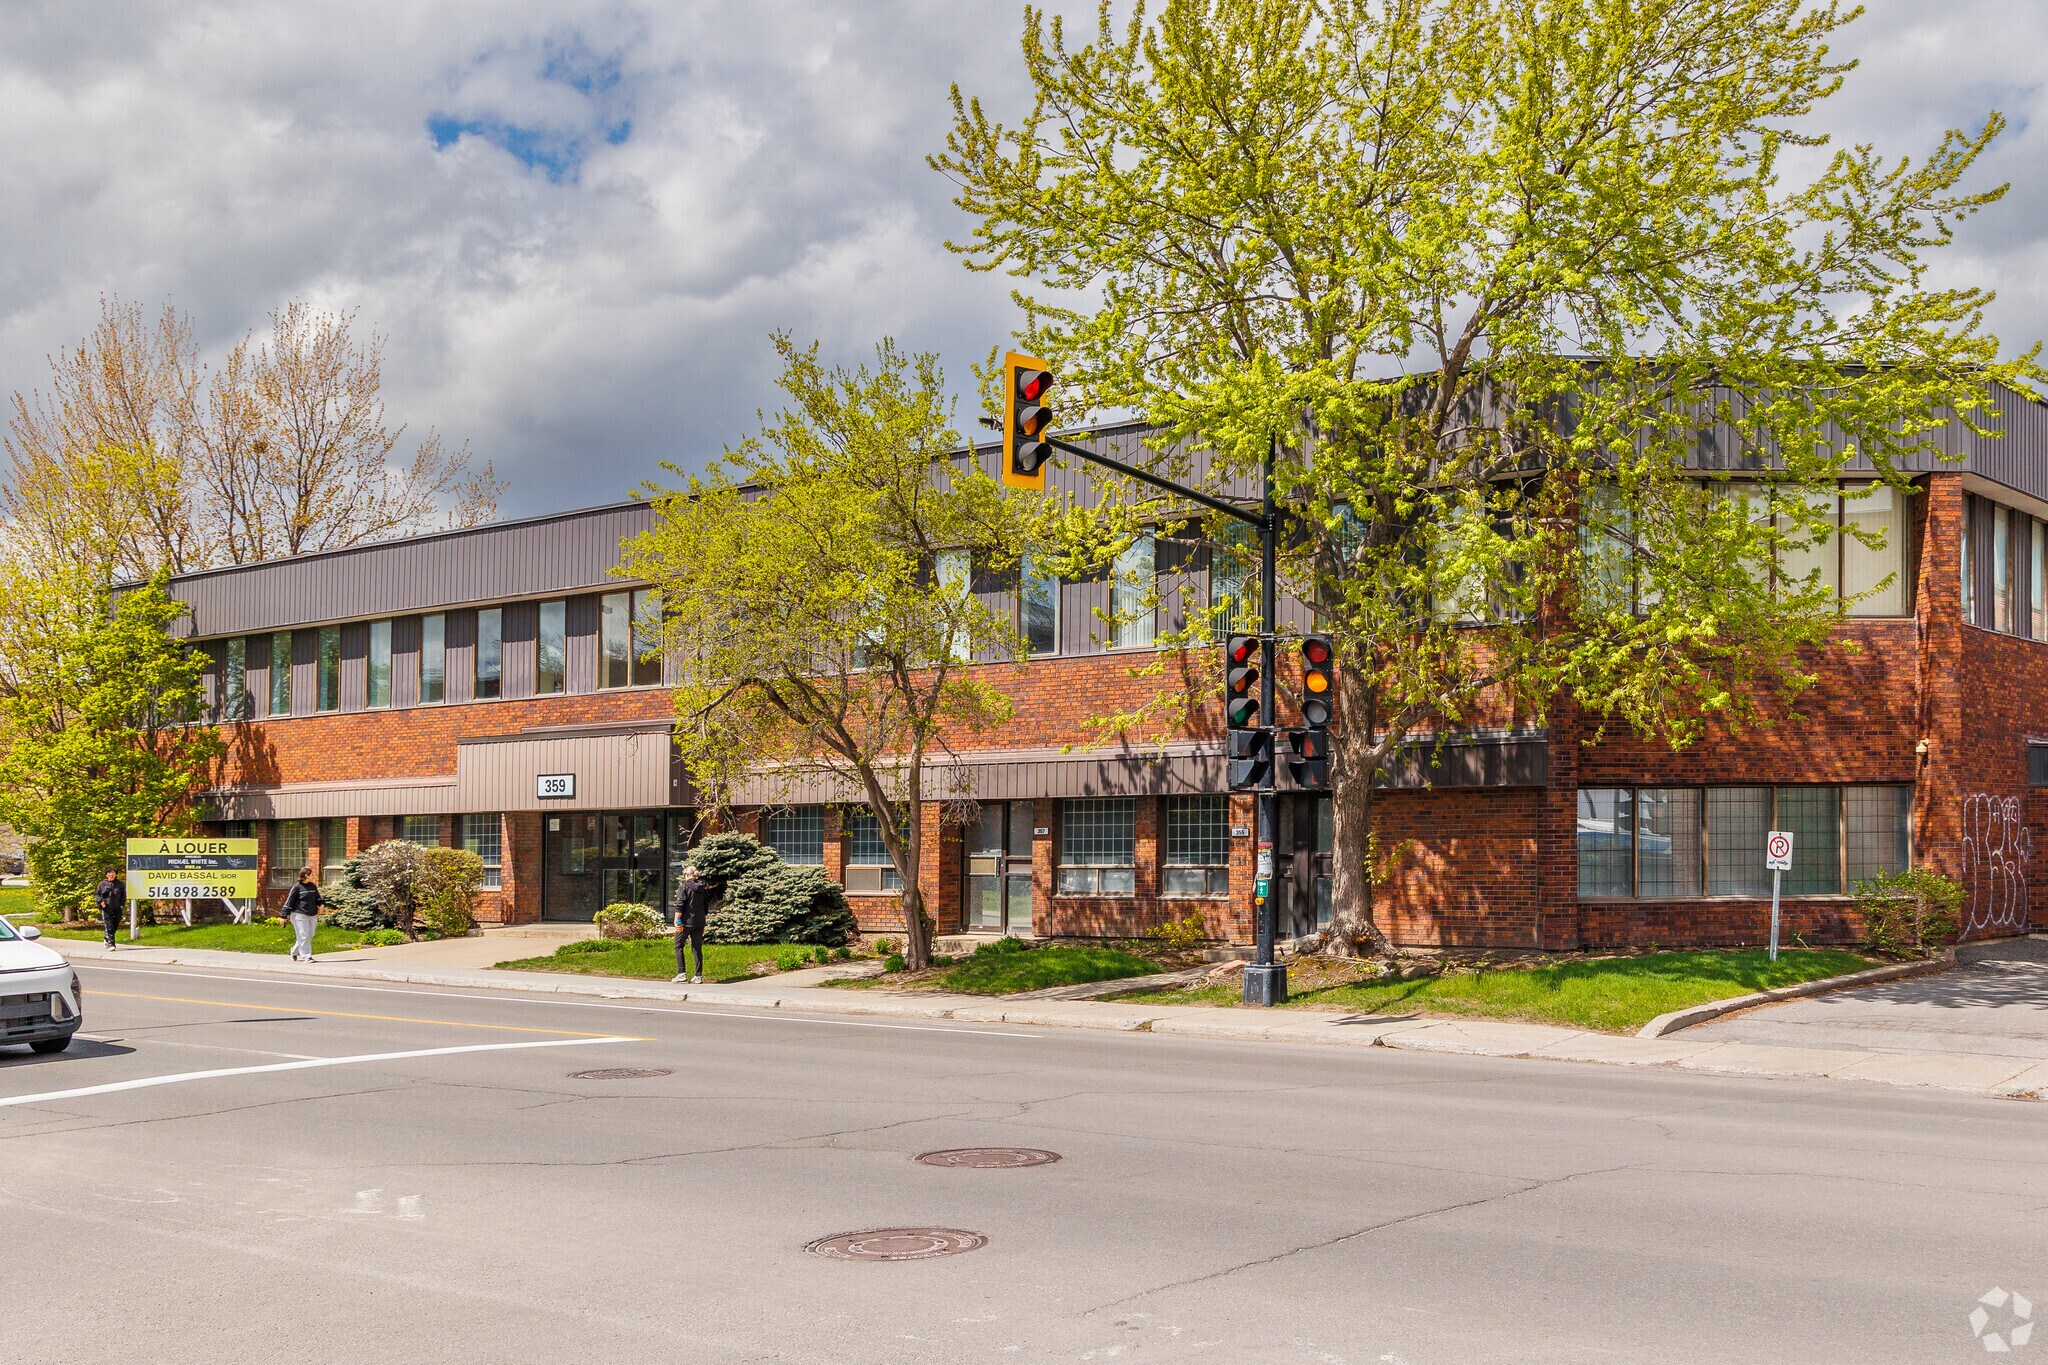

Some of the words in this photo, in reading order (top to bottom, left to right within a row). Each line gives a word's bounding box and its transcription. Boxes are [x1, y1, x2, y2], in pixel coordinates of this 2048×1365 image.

[545, 779, 566, 793] 359
[159, 840, 170, 853] À
[177, 842, 228, 854] LOUER
[148, 872, 177, 880] DAVID
[180, 872, 218, 880] BASSAL
[148, 886, 169, 898] 514
[174, 886, 198, 898] 898
[203, 886, 236, 898] 2589
